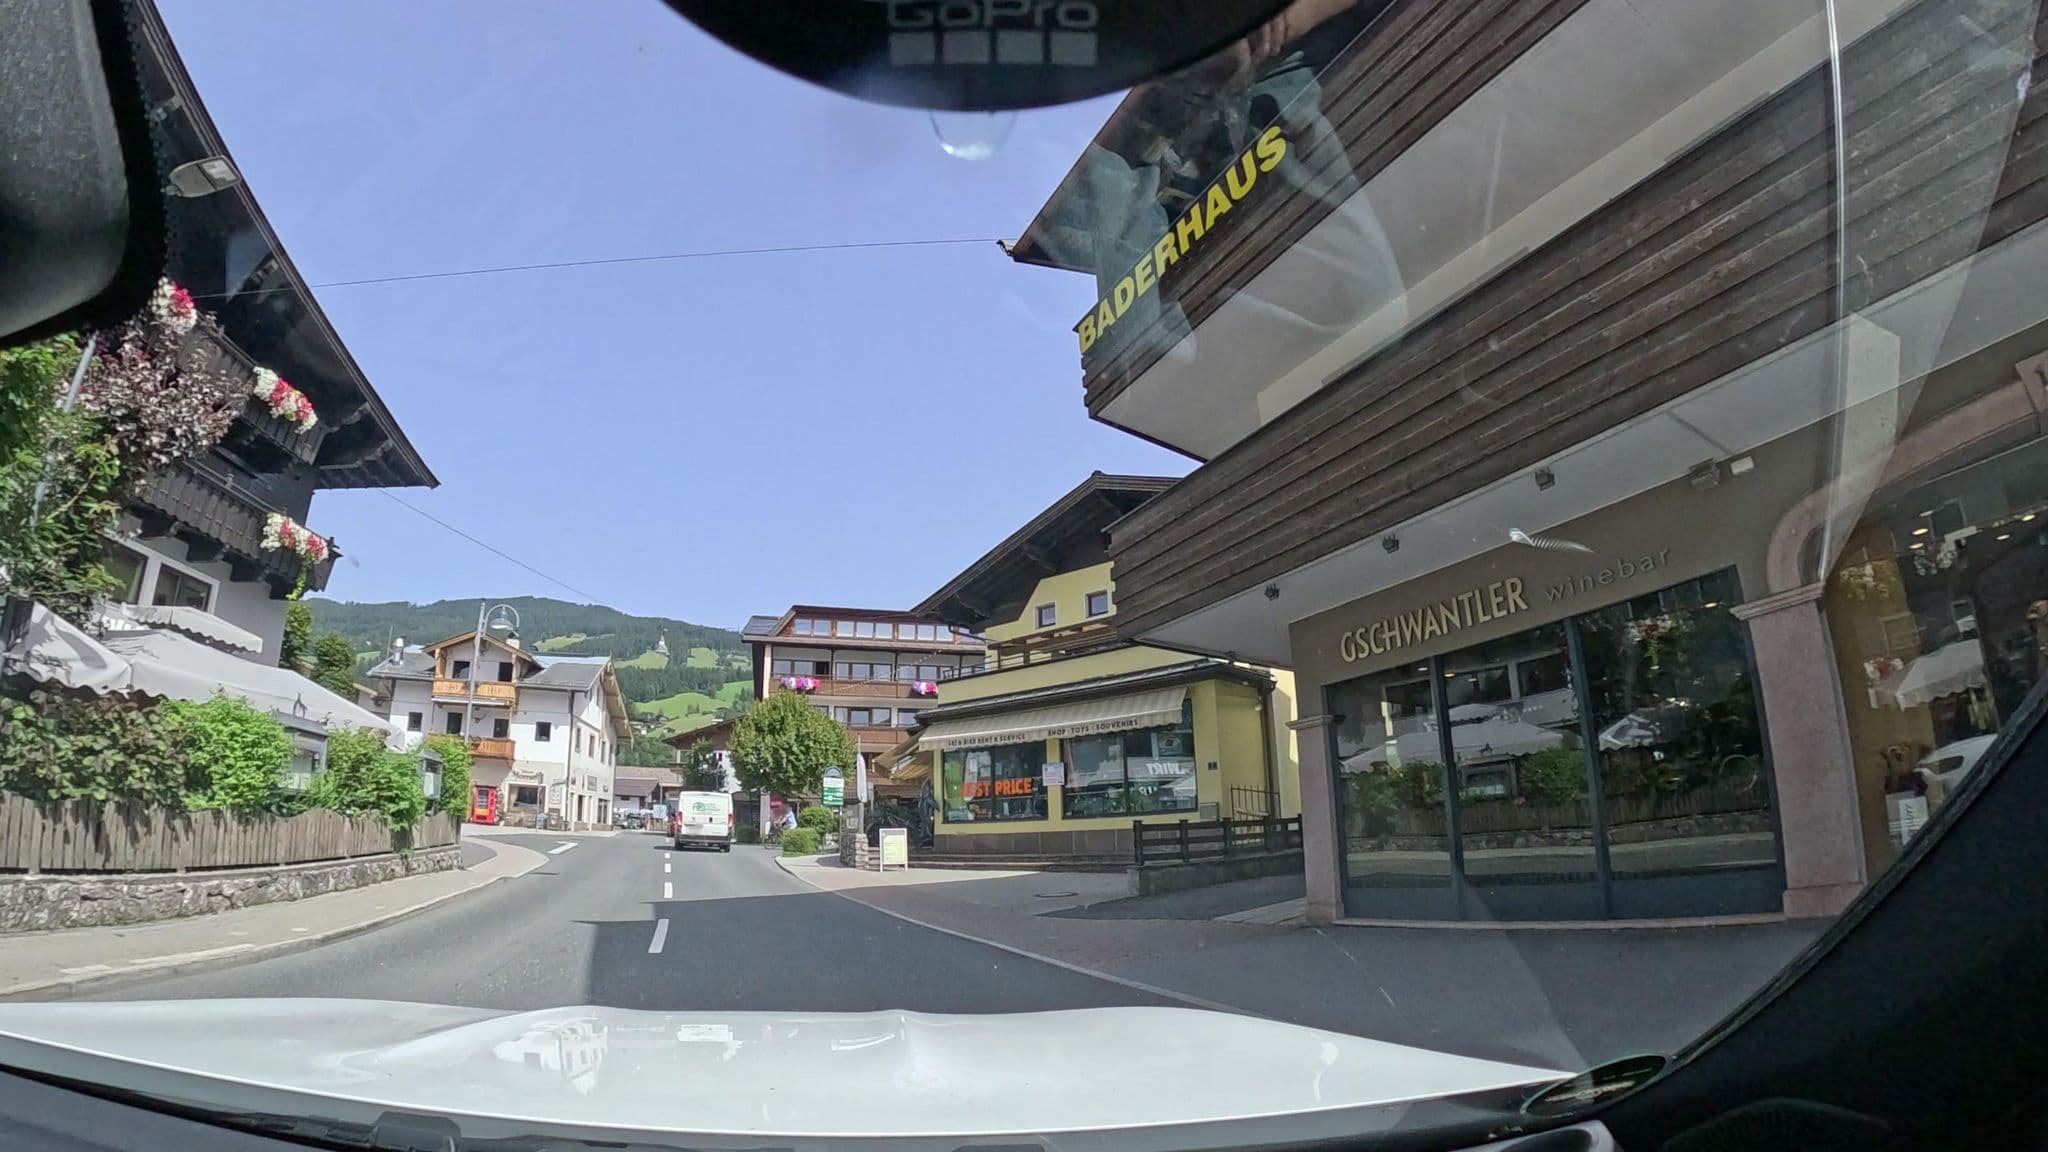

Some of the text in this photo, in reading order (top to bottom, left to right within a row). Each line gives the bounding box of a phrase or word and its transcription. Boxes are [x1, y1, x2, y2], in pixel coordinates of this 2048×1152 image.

[888, 0, 1098, 28] GoPro
[1078, 125, 1287, 353] BADERHAUS
[1340, 548, 1672, 663] GSCHWANTLER winebar
[1048, 719, 1138, 737] SHOP TOYS SOUVENIRS
[995, 777, 1032, 796] PRICE
